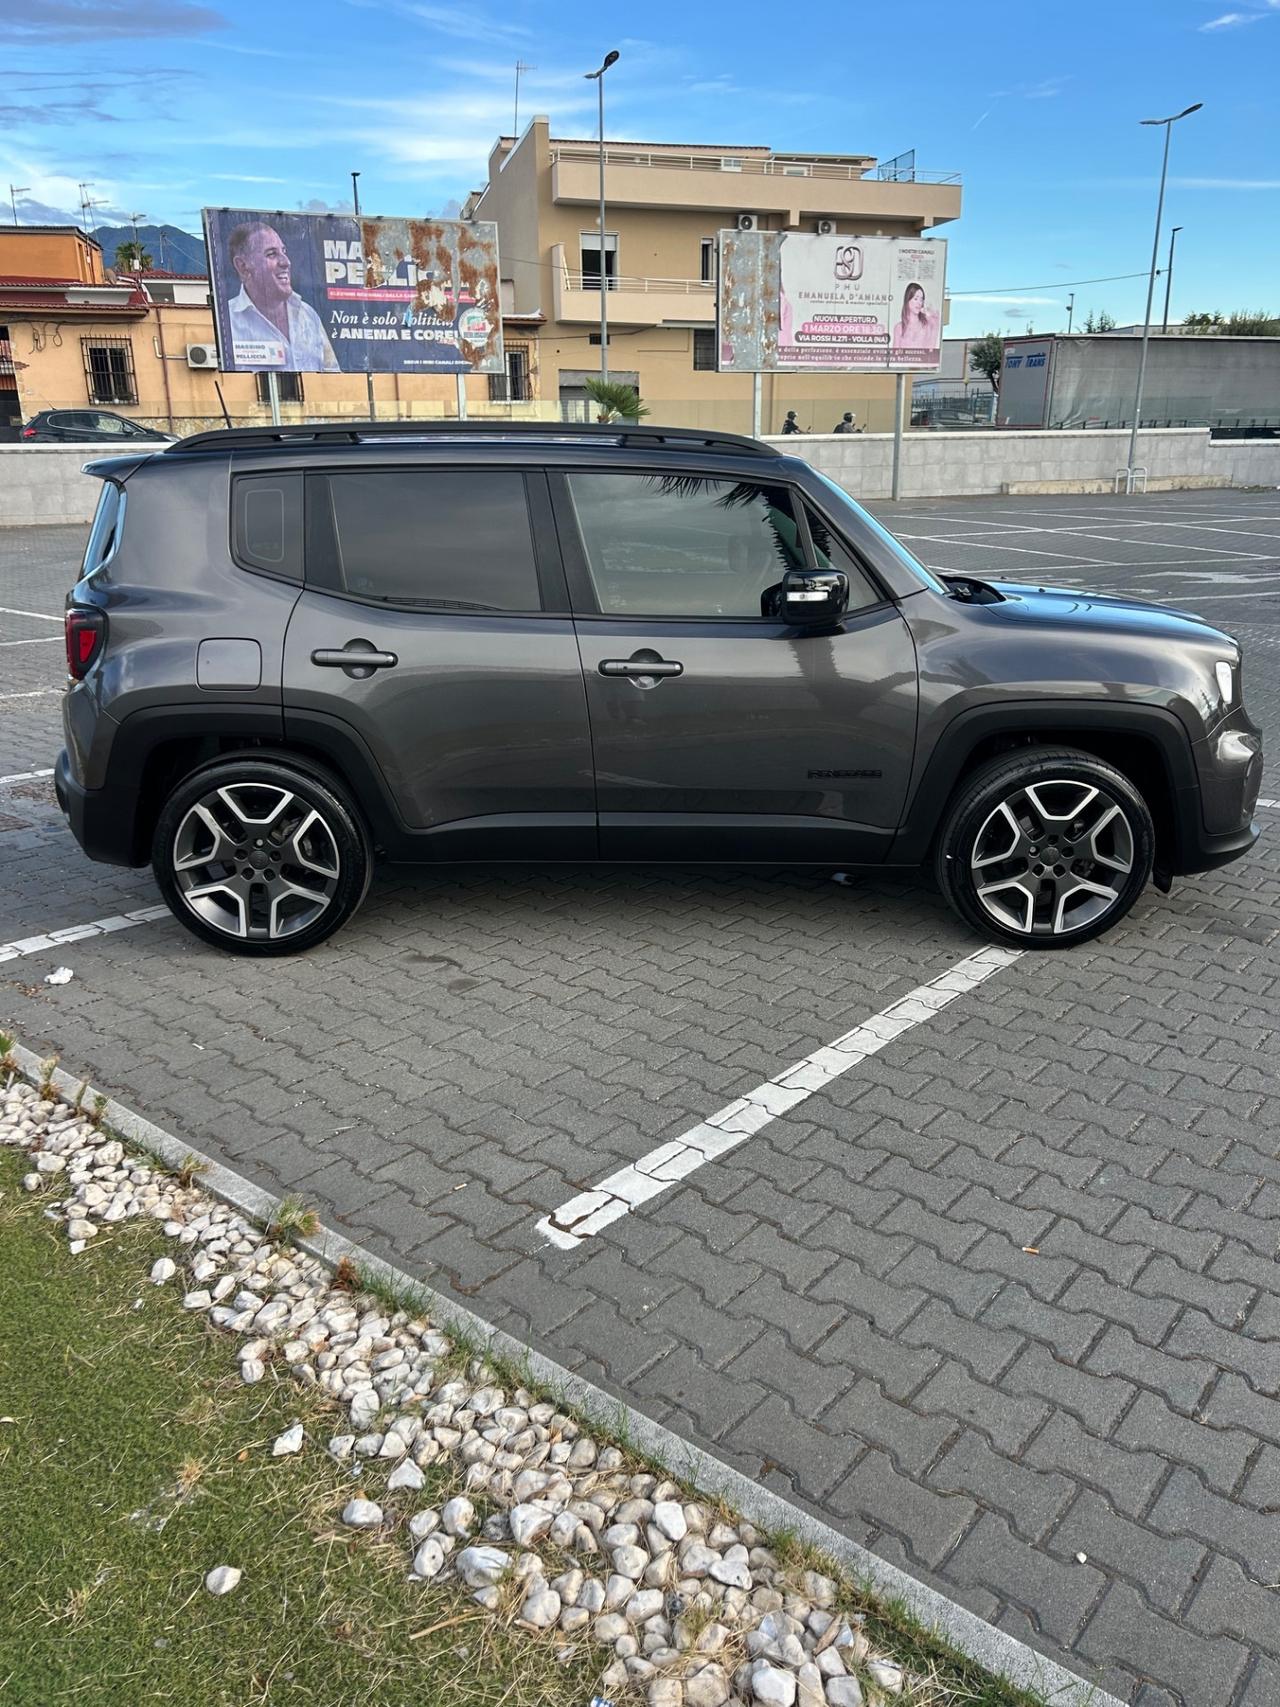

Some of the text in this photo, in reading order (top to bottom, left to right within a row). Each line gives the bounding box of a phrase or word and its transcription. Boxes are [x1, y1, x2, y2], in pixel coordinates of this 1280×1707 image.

[798, 292, 894, 302] EMANUELA D'AMIANO
[330, 310, 359, 324] Non
[362, 312, 370, 324] è
[372, 311, 397, 326] solo
[331, 328, 338, 339] è
[340, 328, 399, 340] ANEMA
[401, 329, 412, 341] E
[809, 324, 841, 333] MARZO
[843, 325, 860, 333] ORE
[1005, 352, 1047, 368] TONY TRANS
